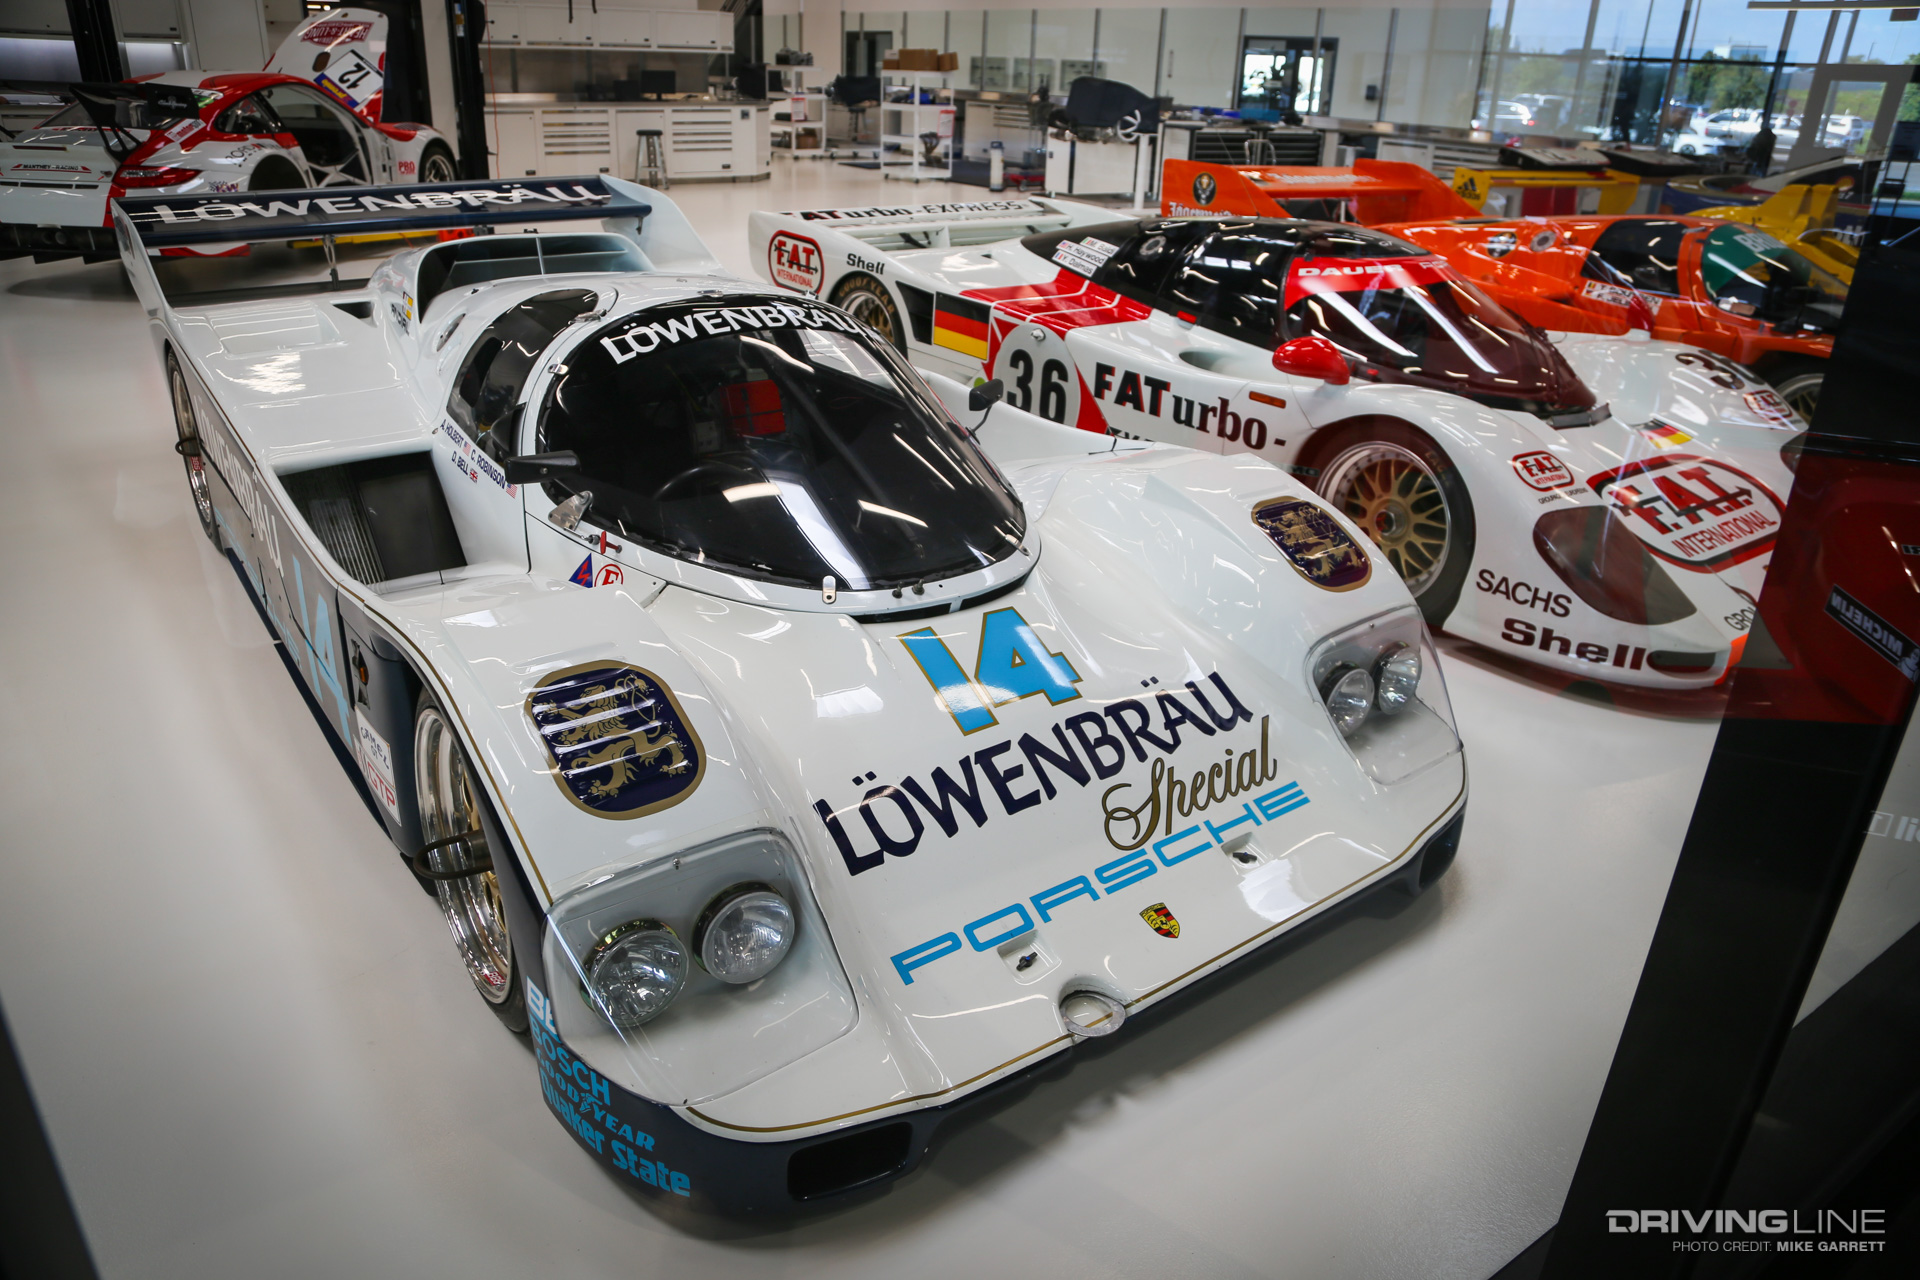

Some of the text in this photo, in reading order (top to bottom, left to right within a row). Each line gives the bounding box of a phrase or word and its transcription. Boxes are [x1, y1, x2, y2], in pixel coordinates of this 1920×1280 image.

[328, 62, 371, 89] 12
[156, 184, 603, 224] LÖWENBRÄU
[846, 252, 886, 276] Shell
[1297, 264, 1404, 276] DAUER
[600, 303, 872, 365] LÖWENBRÄU
[1006, 348, 1069, 425] 36
[444, 422, 465, 449] HOLBERT
[476, 454, 508, 490] ROBINSON
[456, 457, 470, 477] BELL
[1671, 509, 1779, 559] INTERNATIONAL
[1475, 568, 1573, 619] SACHS
[896, 606, 1084, 736] 14
[1501, 617, 1648, 671] Shell
[813, 671, 1254, 877] LÖWENBRÄU
[1101, 714, 1278, 852] Special
[890, 780, 1312, 986] PORSCHE
[530, 1012, 612, 1107] BOSCH
[539, 1065, 691, 1198] Quaker State
